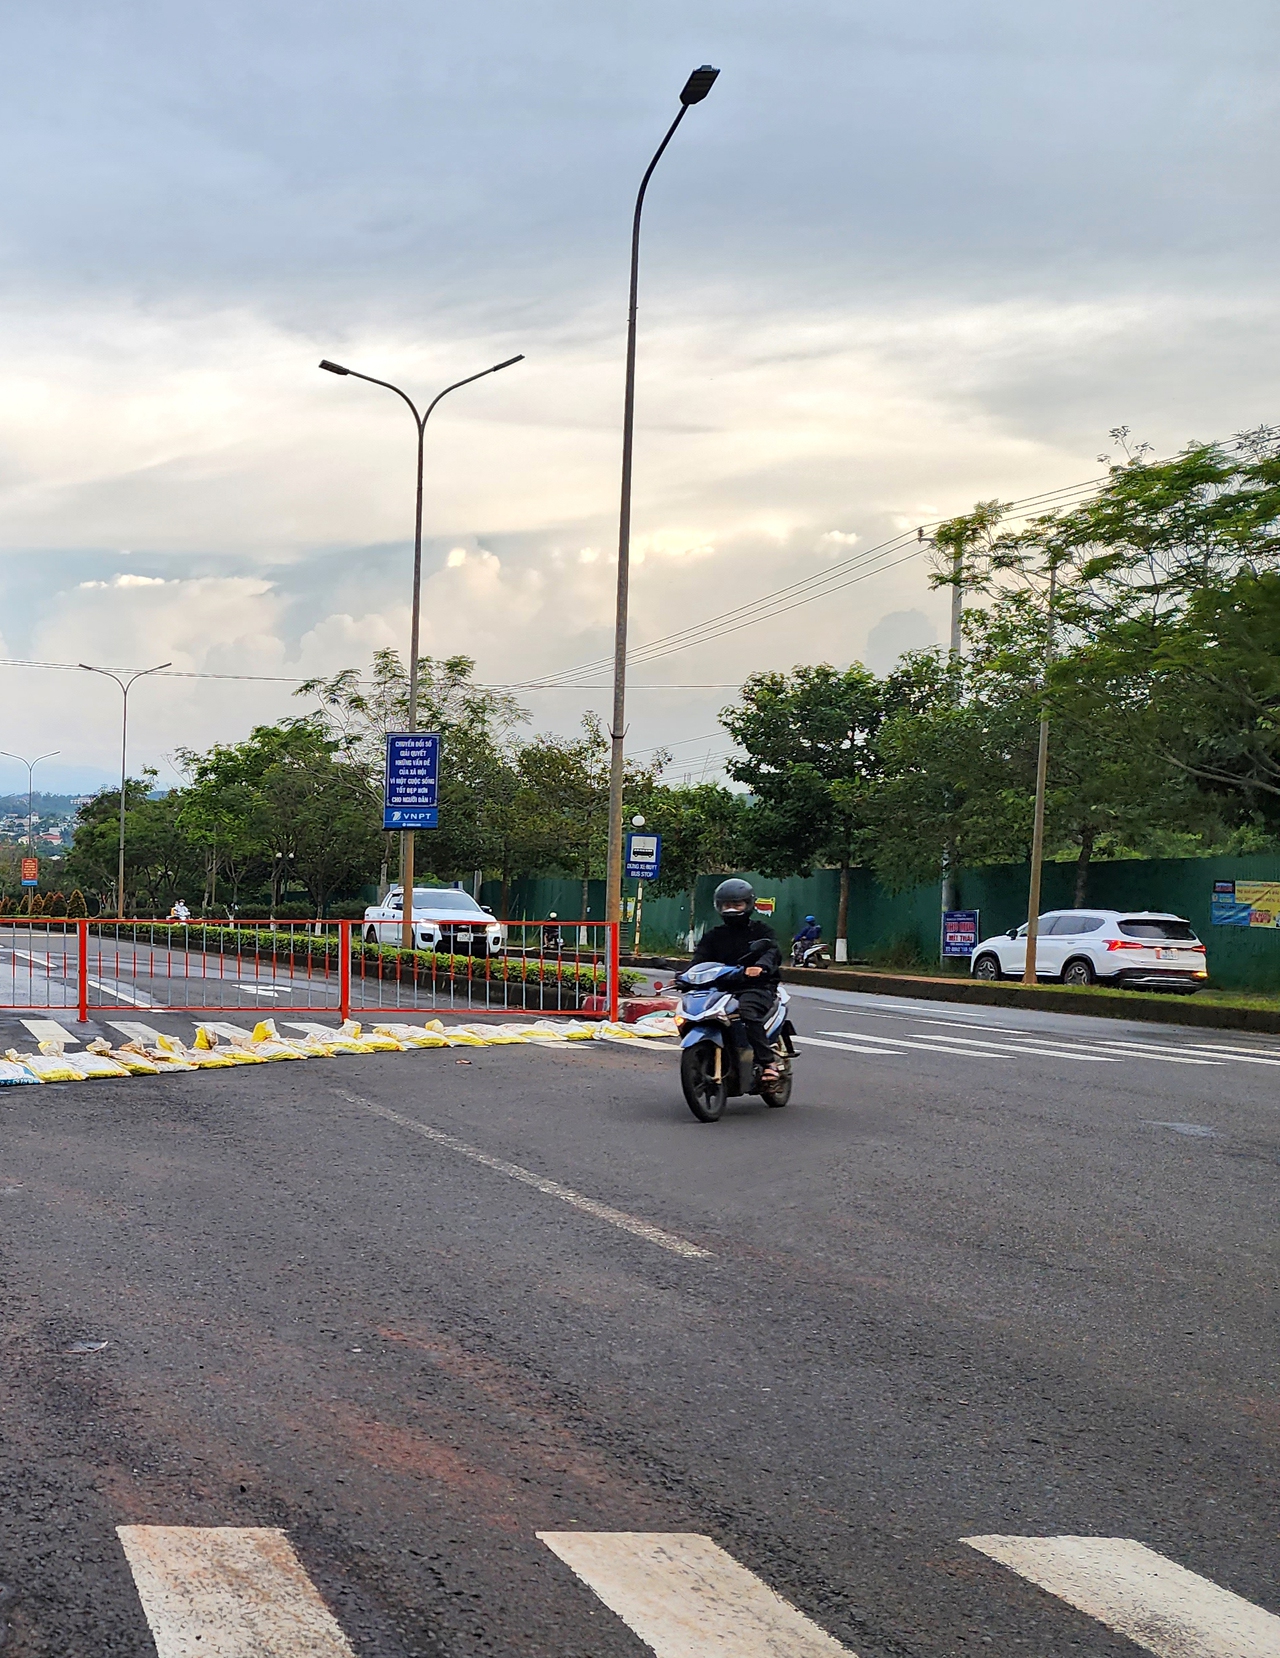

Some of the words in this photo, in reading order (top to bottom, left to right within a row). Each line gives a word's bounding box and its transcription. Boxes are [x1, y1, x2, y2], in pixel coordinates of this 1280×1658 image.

[425, 739, 432, 747] SỐ
[399, 767, 409, 775] CỦA
[407, 777, 420, 785] CUỘC
[421, 776, 434, 784] SỐNG
